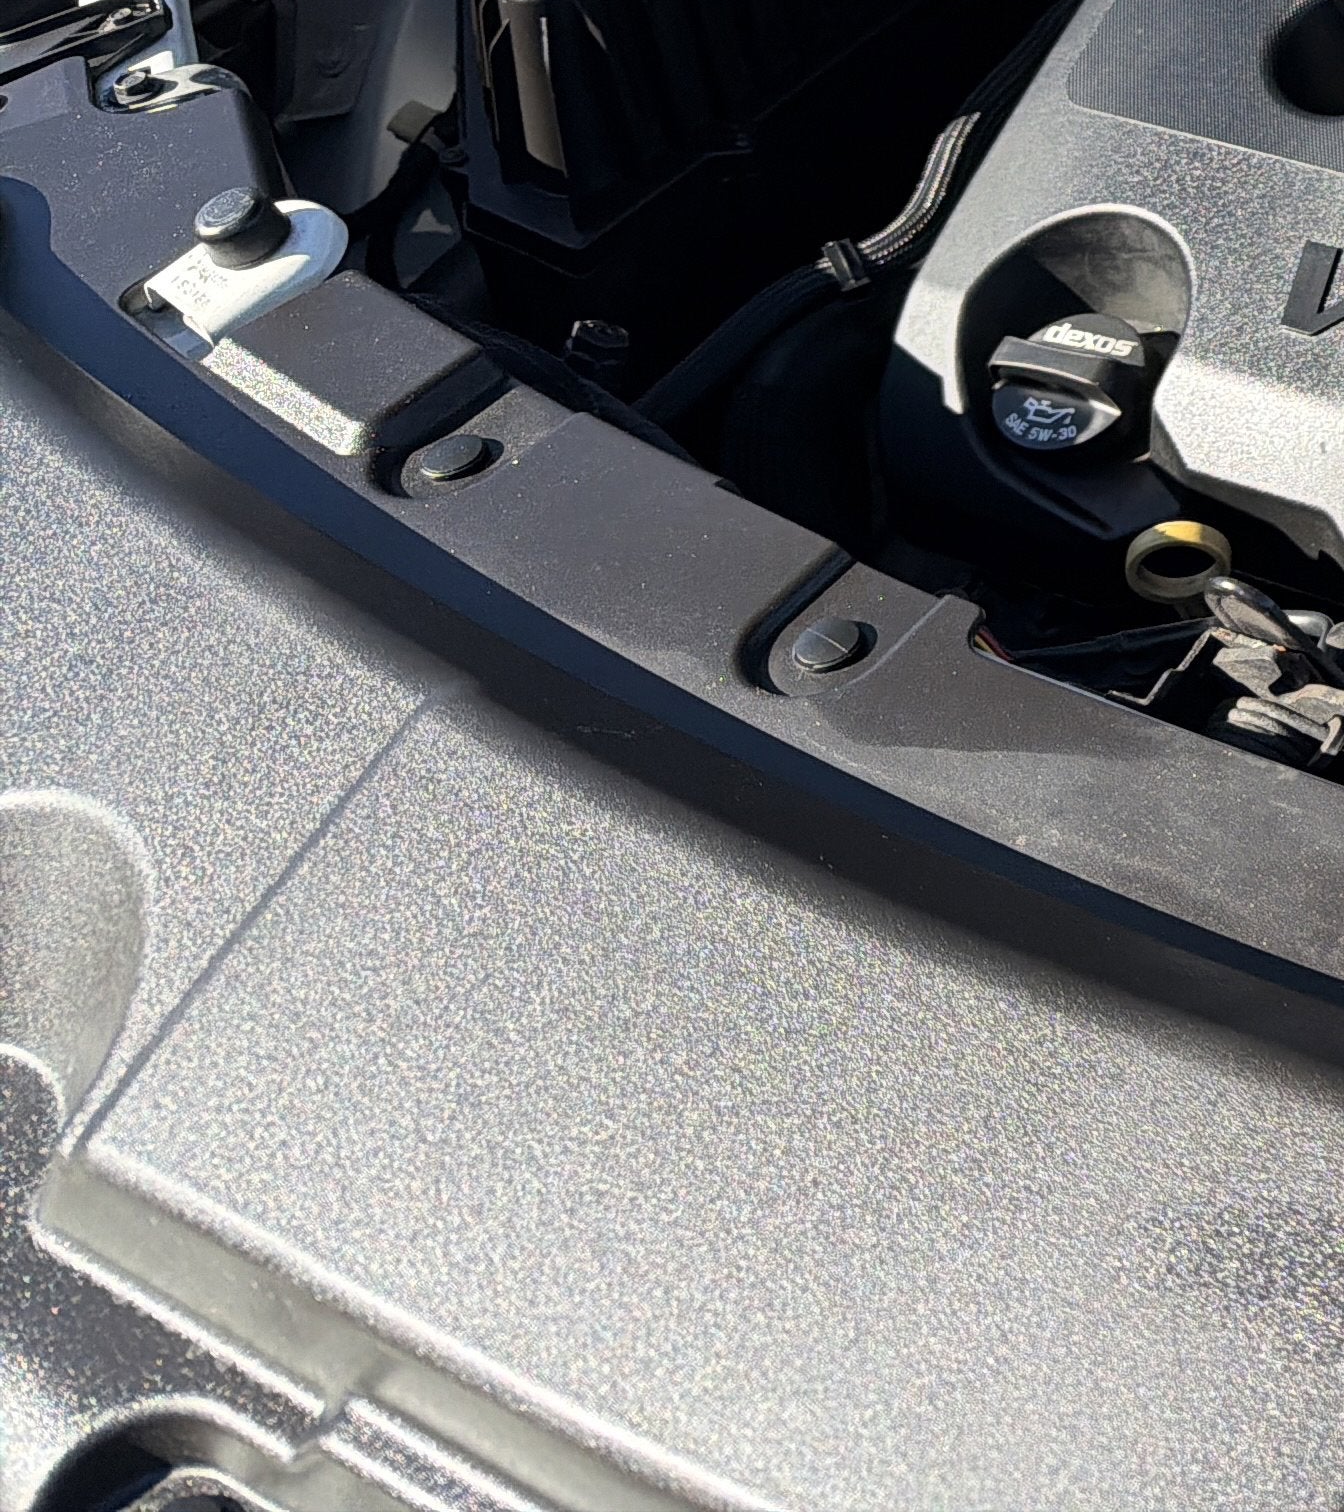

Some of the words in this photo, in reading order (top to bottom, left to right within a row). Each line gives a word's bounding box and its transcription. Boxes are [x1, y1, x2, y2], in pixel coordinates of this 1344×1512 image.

[1043, 322, 1138, 356] dexos
[1005, 412, 1029, 436] SAE
[1028, 425, 1077, 442] 5W-30
